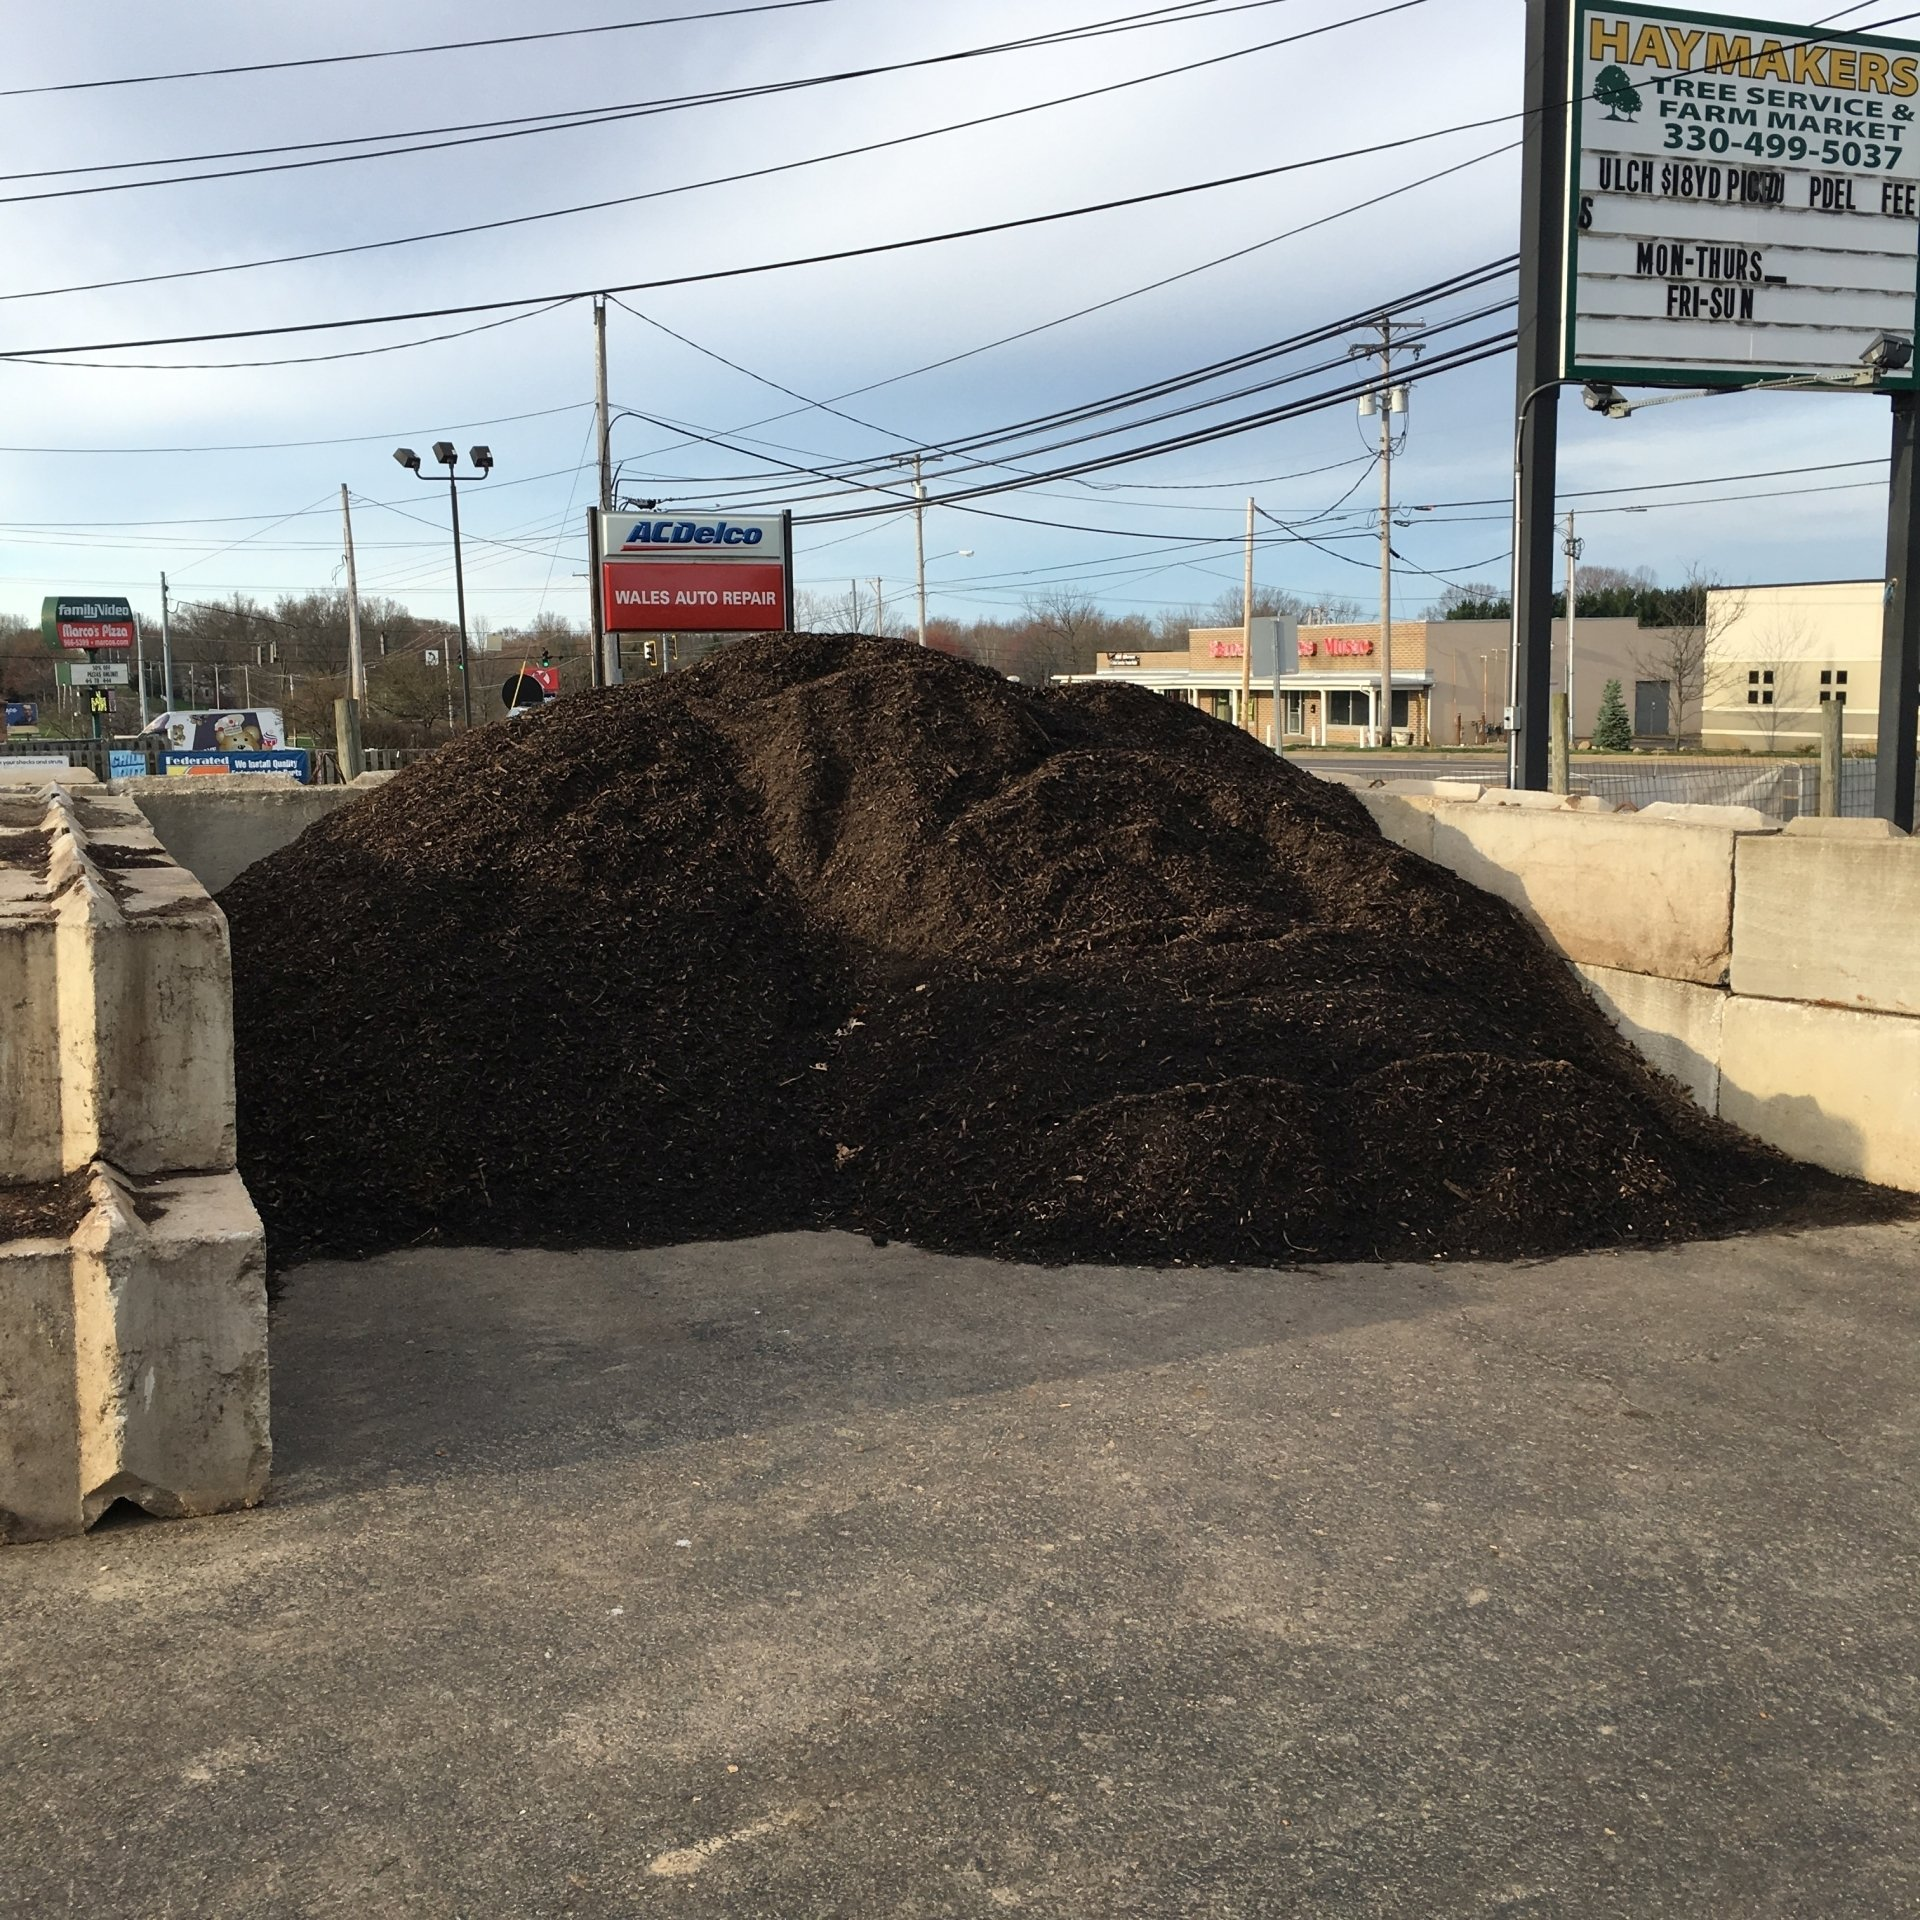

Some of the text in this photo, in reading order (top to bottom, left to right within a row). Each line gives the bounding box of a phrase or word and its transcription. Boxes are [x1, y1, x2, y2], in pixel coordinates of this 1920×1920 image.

[1590, 18, 1919, 97] HAYMAKERS
[1650, 76, 1915, 122] TREE SERVICE &
[1660, 101, 1906, 141] FARM MARKET
[1663, 123, 1903, 170] 330-499-5037
[1599, 157, 1654, 193] ULCH
[1809, 176, 1856, 210] PDEL
[1881, 183, 1916, 215] FEE
[1578, 197, 1594, 230] S
[626, 521, 763, 545] ACDelco
[615, 590, 776, 606] WALES AUTO REPAIR
[62, 624, 128, 637] Marco's Pizza
[165, 756, 229, 765] Federated
[234, 759, 298, 769] We Install Quality
